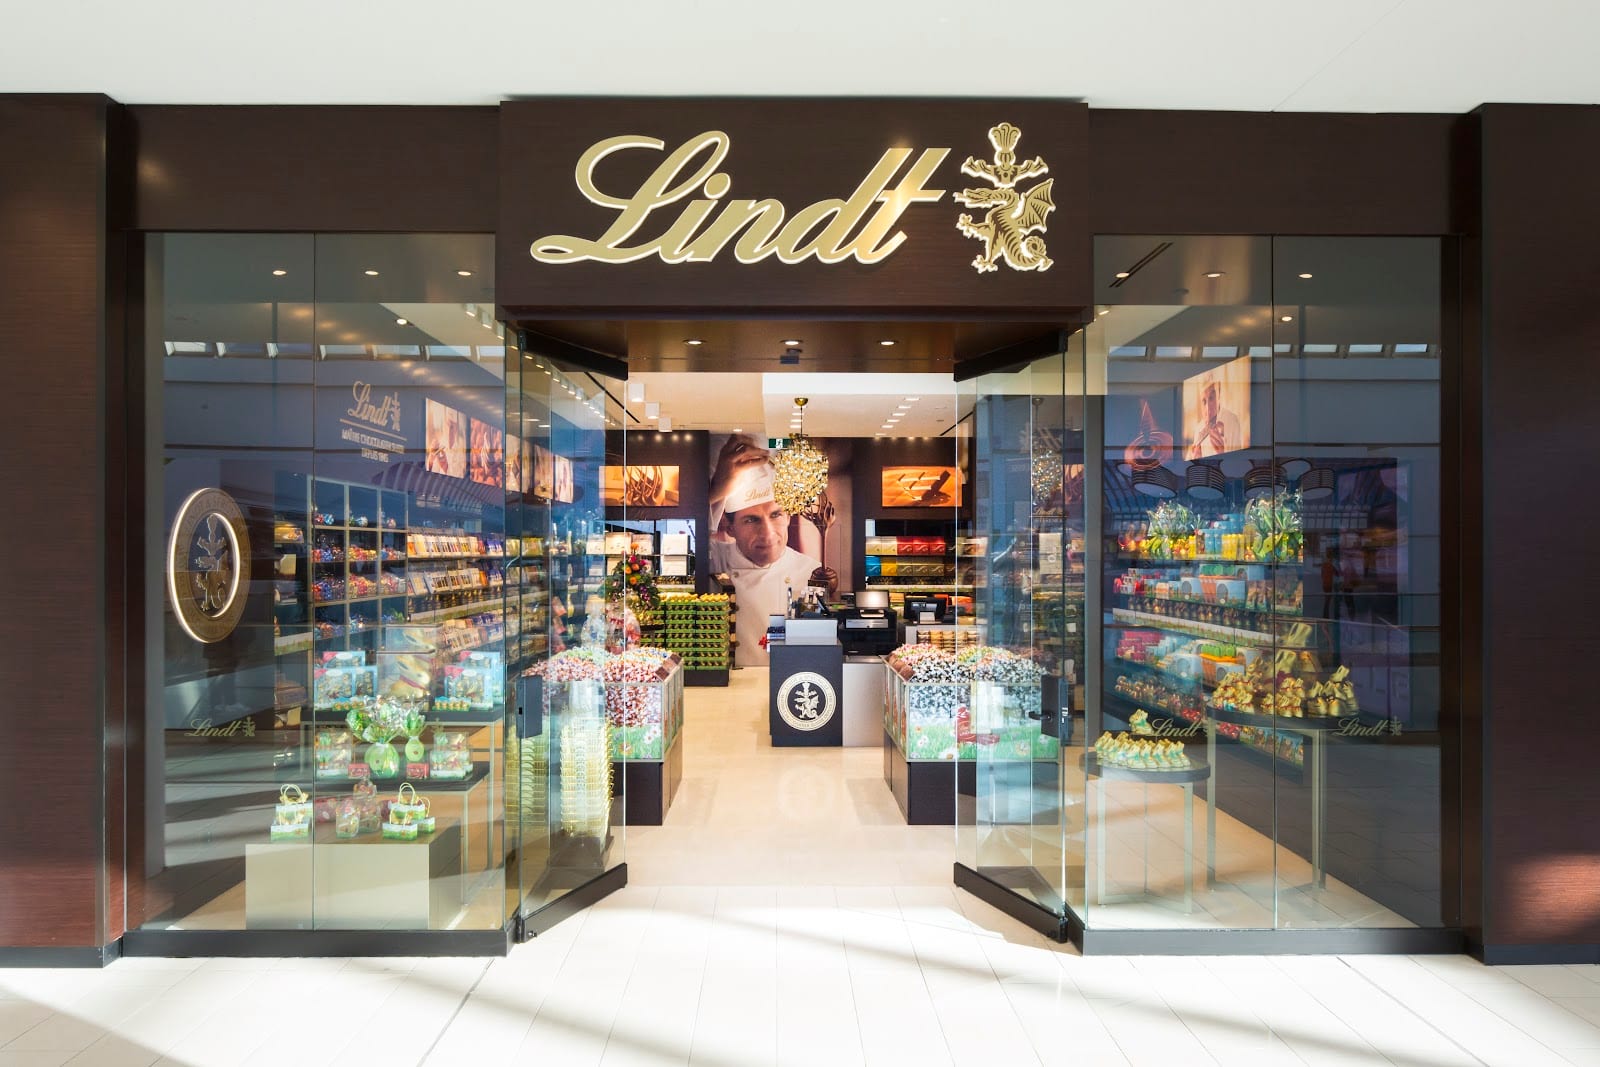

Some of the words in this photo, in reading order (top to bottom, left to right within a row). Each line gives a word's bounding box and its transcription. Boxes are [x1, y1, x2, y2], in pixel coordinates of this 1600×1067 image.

[530, 130, 951, 264] Lindt
[347, 380, 392, 427] Lindt
[184, 718, 242, 737] Lindt
[1145, 718, 1202, 737] Lindt
[1332, 717, 1388, 737] Lindt
